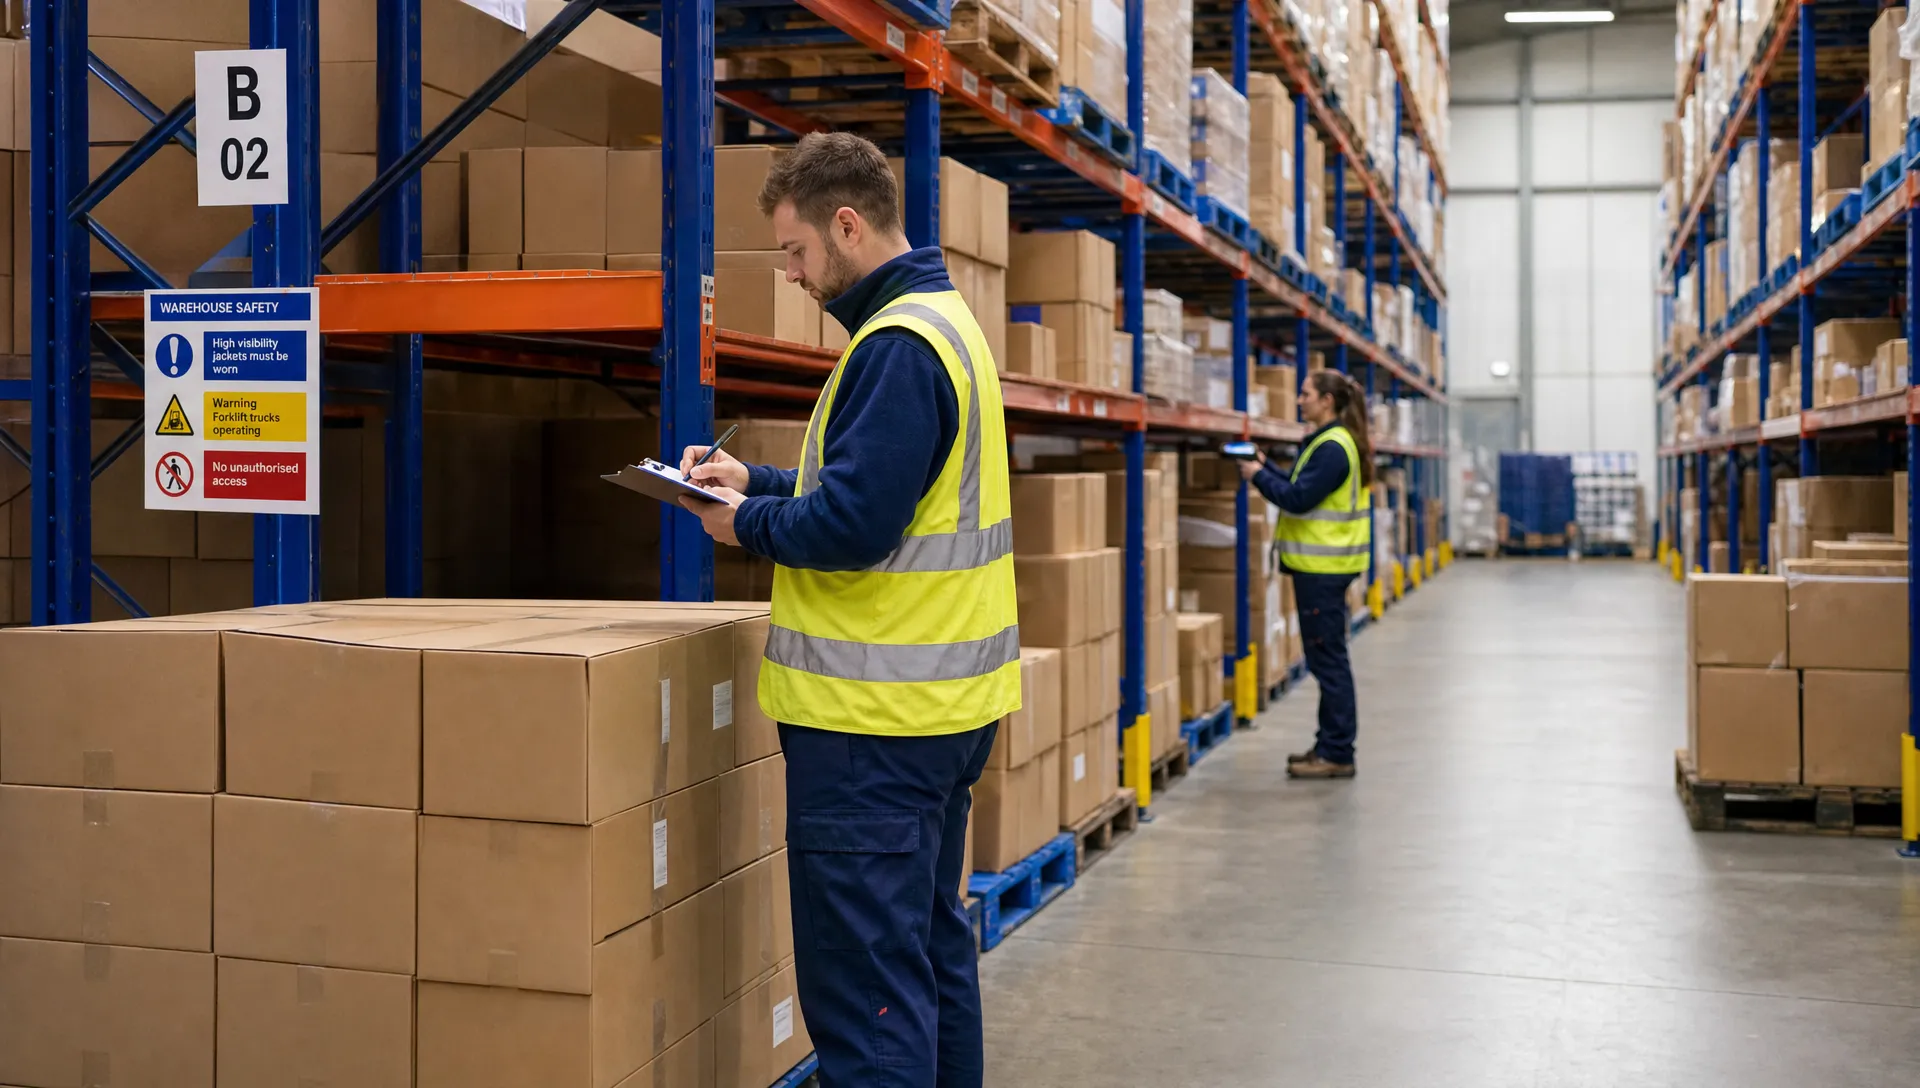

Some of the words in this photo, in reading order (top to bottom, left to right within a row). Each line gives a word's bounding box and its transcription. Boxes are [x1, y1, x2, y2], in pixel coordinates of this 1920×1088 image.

[227, 66, 261, 121] B
[220, 137, 269, 181] 02
[160, 302, 233, 314] WAREHOUSE
[236, 301, 279, 313] SAFETY
[212, 338, 236, 350] High
[238, 338, 279, 350] visibility
[212, 351, 248, 363] jackets
[249, 351, 274, 361] must
[276, 351, 289, 361] be
[212, 365, 239, 374] worn
[212, 397, 257, 410] Warning
[213, 412, 248, 422] Forklift
[249, 413, 280, 422] trucks
[212, 425, 261, 437] operating
[212, 461, 228, 472] No
[229, 462, 299, 473] unauthorised
[212, 477, 247, 486] access
